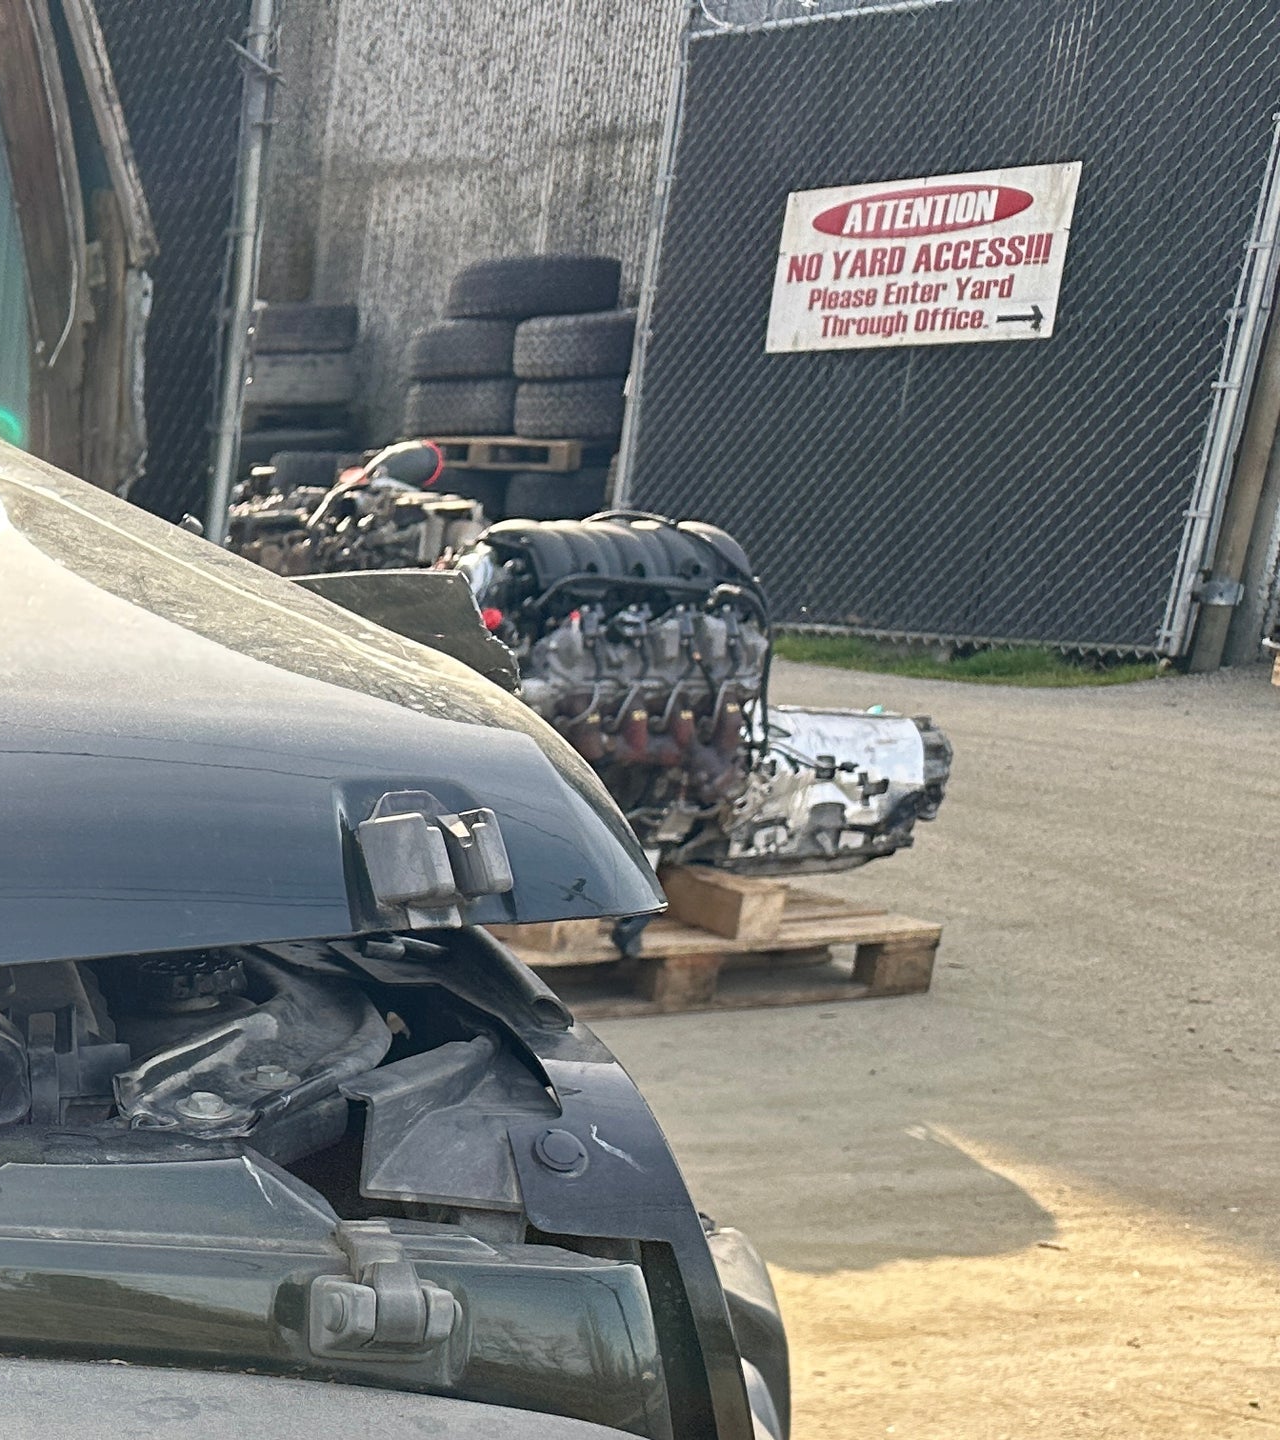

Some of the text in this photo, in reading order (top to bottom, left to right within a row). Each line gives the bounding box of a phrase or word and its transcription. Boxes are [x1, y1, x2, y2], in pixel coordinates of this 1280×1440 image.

[842, 189, 1000, 235] ATTENTION
[787, 232, 1054, 284] NO YARD ACCESS!!!
[808, 274, 1016, 311] Please Enter Yard
[821, 311, 909, 338] Through
